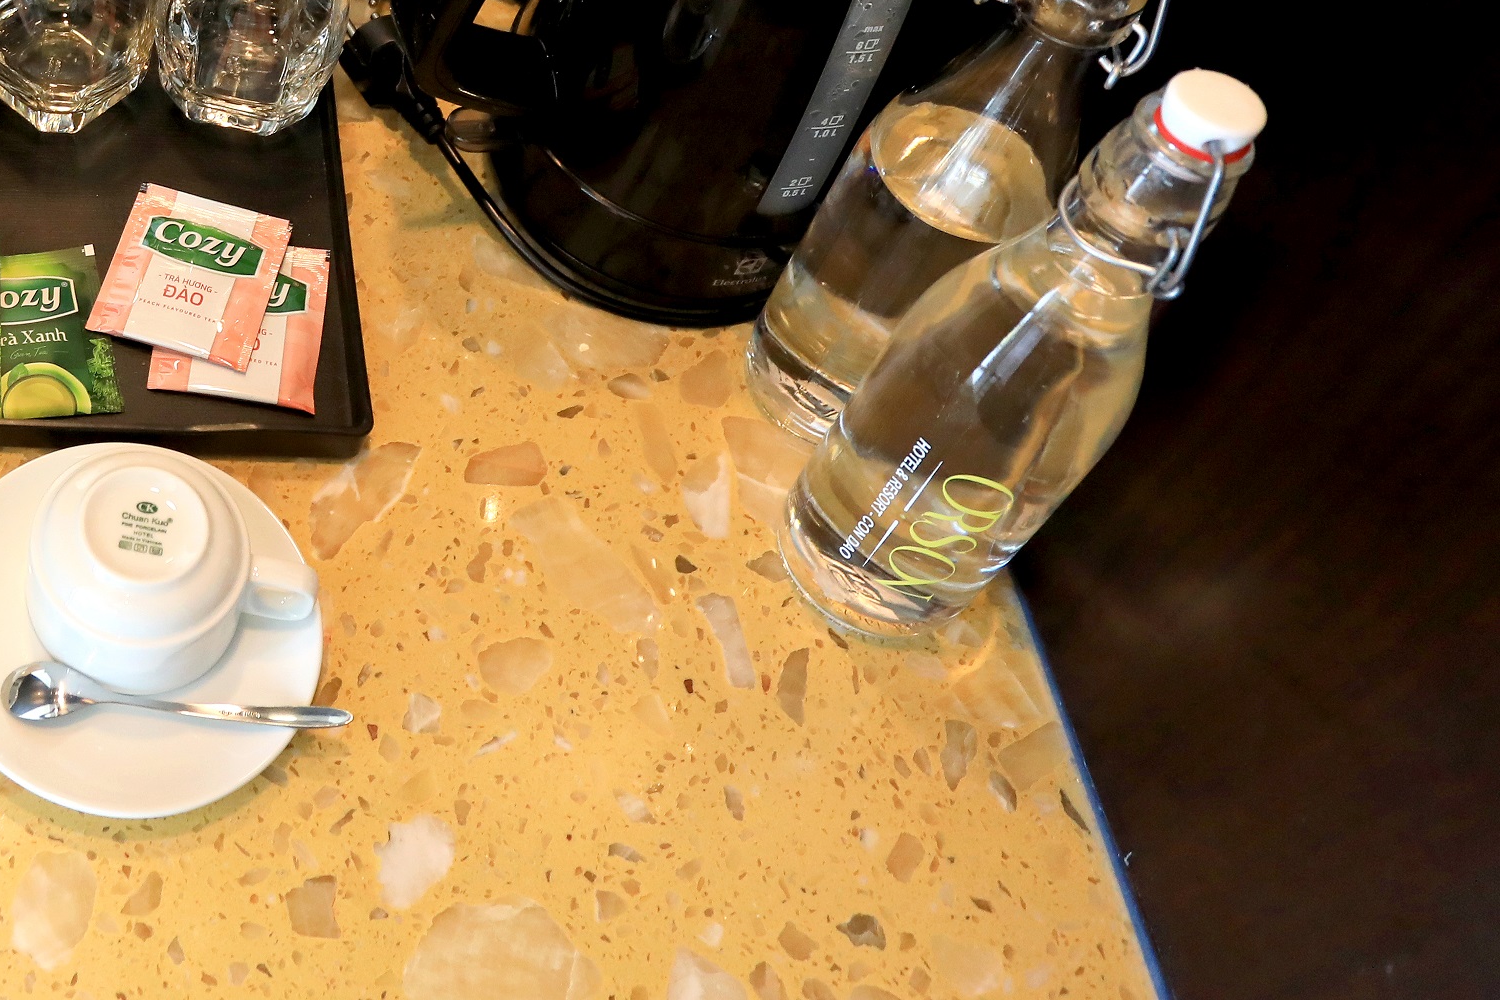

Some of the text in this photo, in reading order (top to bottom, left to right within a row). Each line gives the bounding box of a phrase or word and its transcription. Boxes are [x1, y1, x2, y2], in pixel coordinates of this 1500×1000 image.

[864, 24, 884, 34] max
[856, 41, 864, 50] 6
[821, 117, 829, 126] 4
[813, 130, 829, 138] 1.0
[789, 178, 798, 187] 2
[154, 220, 247, 267] Cozy
[164, 272, 181, 284] TRÀ
[0, 284, 61, 312] ozy
[162, 283, 204, 307] ĐÀO
[139, 297, 217, 324] PEACH FLAVOURED TEA
[0, 328, 68, 347] rà Xanh
[900, 437, 933, 474] HOTEL
[871, 475, 903, 518] RESORT
[121, 512, 149, 523] Chuan
[852, 515, 875, 542] CON
[839, 535, 861, 561] DAO
